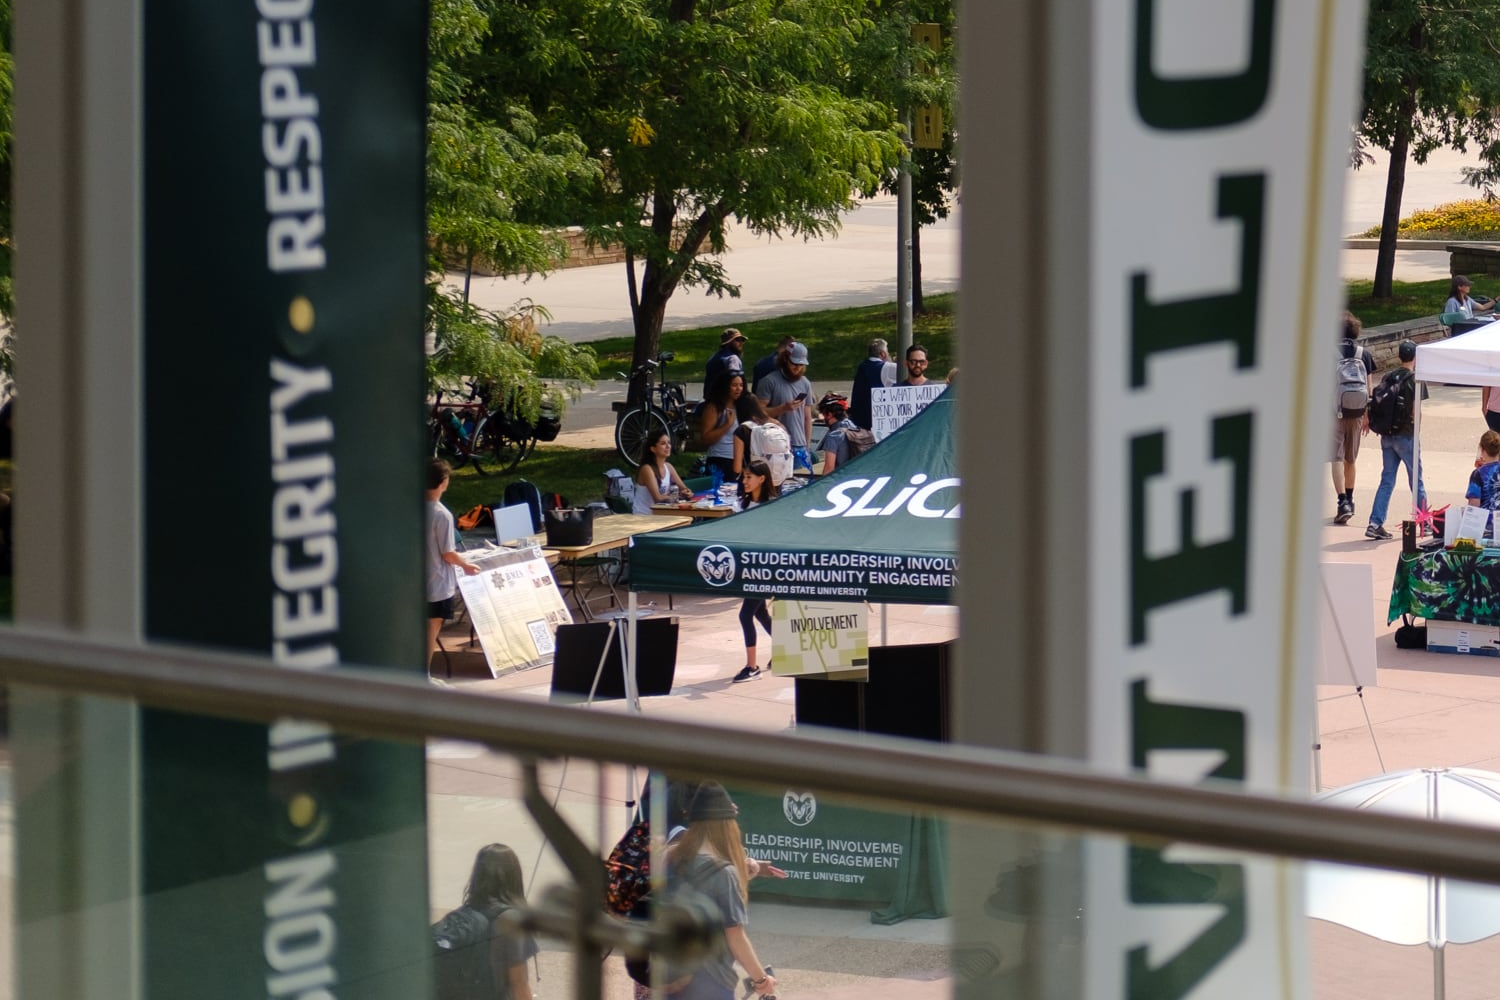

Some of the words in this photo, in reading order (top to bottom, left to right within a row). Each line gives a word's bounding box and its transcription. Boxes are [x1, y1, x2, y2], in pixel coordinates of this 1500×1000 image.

[872, 389, 886, 403] Q:
[890, 387, 912, 402] WHAT
[915, 385, 941, 401] WOULD
[872, 403, 894, 417] SPEND
[896, 403, 913, 416] YOUR
[876, 418, 885, 431] IF
[803, 473, 961, 518] SLiC
[741, 552, 808, 566] STUDENT
[812, 553, 905, 571] LEADERSHIP,
[741, 568, 772, 580] AND
[775, 569, 866, 583] COMMUNITY
[743, 584, 788, 594] COLORADO
[790, 585, 816, 595] STATE
[817, 587, 869, 596] UNIVERSITY
[790, 613, 858, 633] INVOLVEMENT
[799, 629, 838, 651] EXPO
[745, 833, 825, 850] LEADERSHIP,
[813, 853, 899, 868] ENGAGEMENT
[784, 870, 811, 880] STATE
[813, 871, 865, 884] UNIVERSITY
[262, 849, 337, 1000] ION
